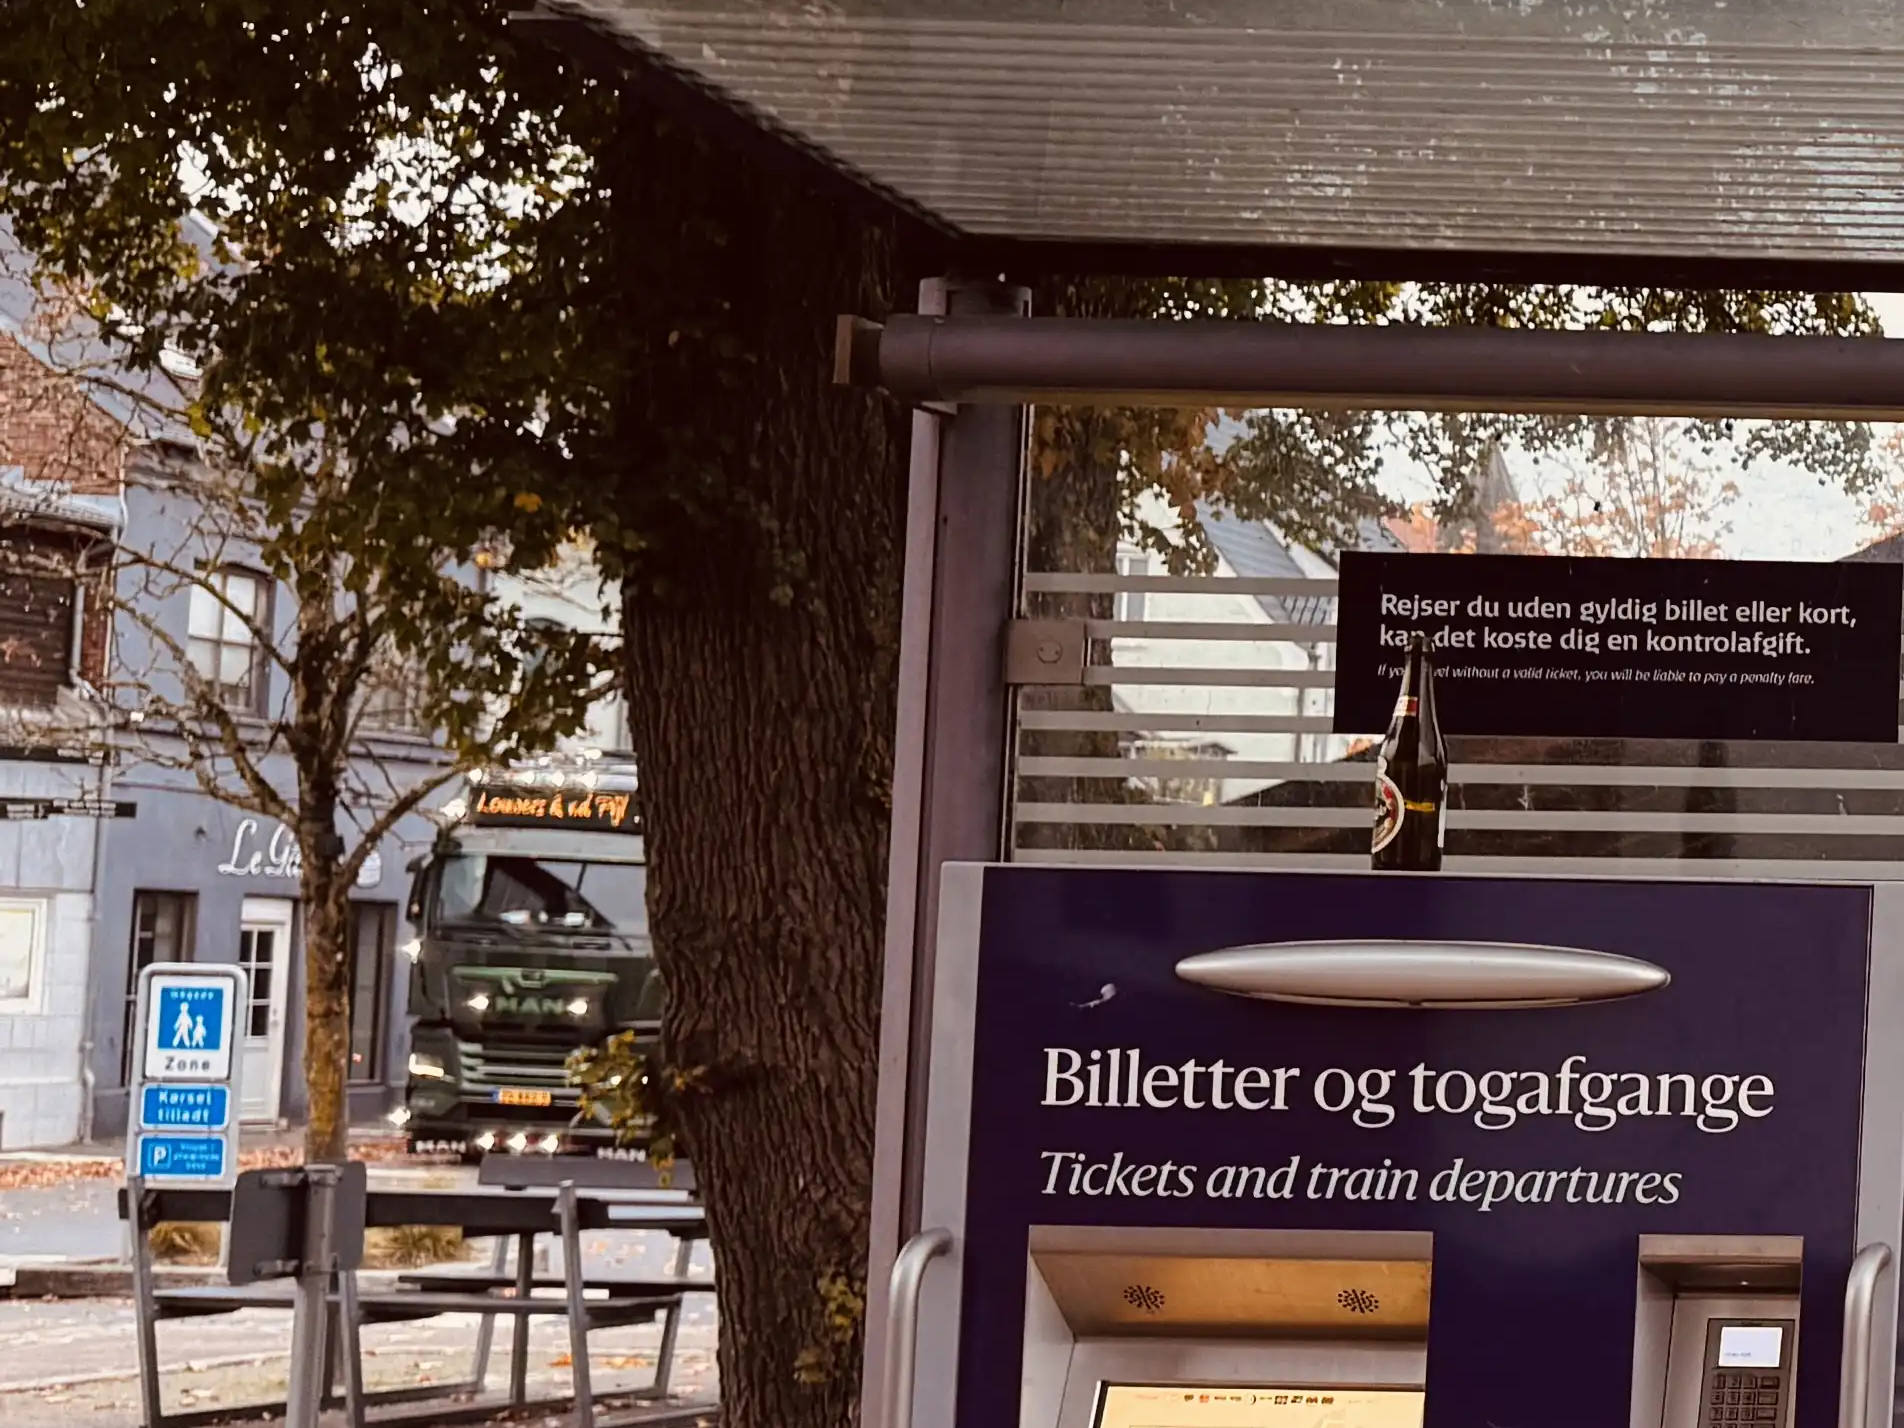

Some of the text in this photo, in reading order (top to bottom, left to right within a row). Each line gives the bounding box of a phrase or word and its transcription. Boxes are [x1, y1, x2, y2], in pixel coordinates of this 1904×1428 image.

[1382, 594, 1856, 627] Rejser du uden gyldig billet eller kort,
[1433, 625, 1476, 647] det
[1484, 627, 1552, 649] koste
[1560, 628, 1599, 654] dig
[1608, 635, 1637, 650] en
[1647, 629, 1810, 657] kontrolafgift.
[496, 996, 564, 1013] MAN
[165, 1056, 210, 1071] Zone
[1041, 1048, 1774, 1132] Billetter og togafgange
[1041, 1152, 1682, 1211] Tickets and train departures
